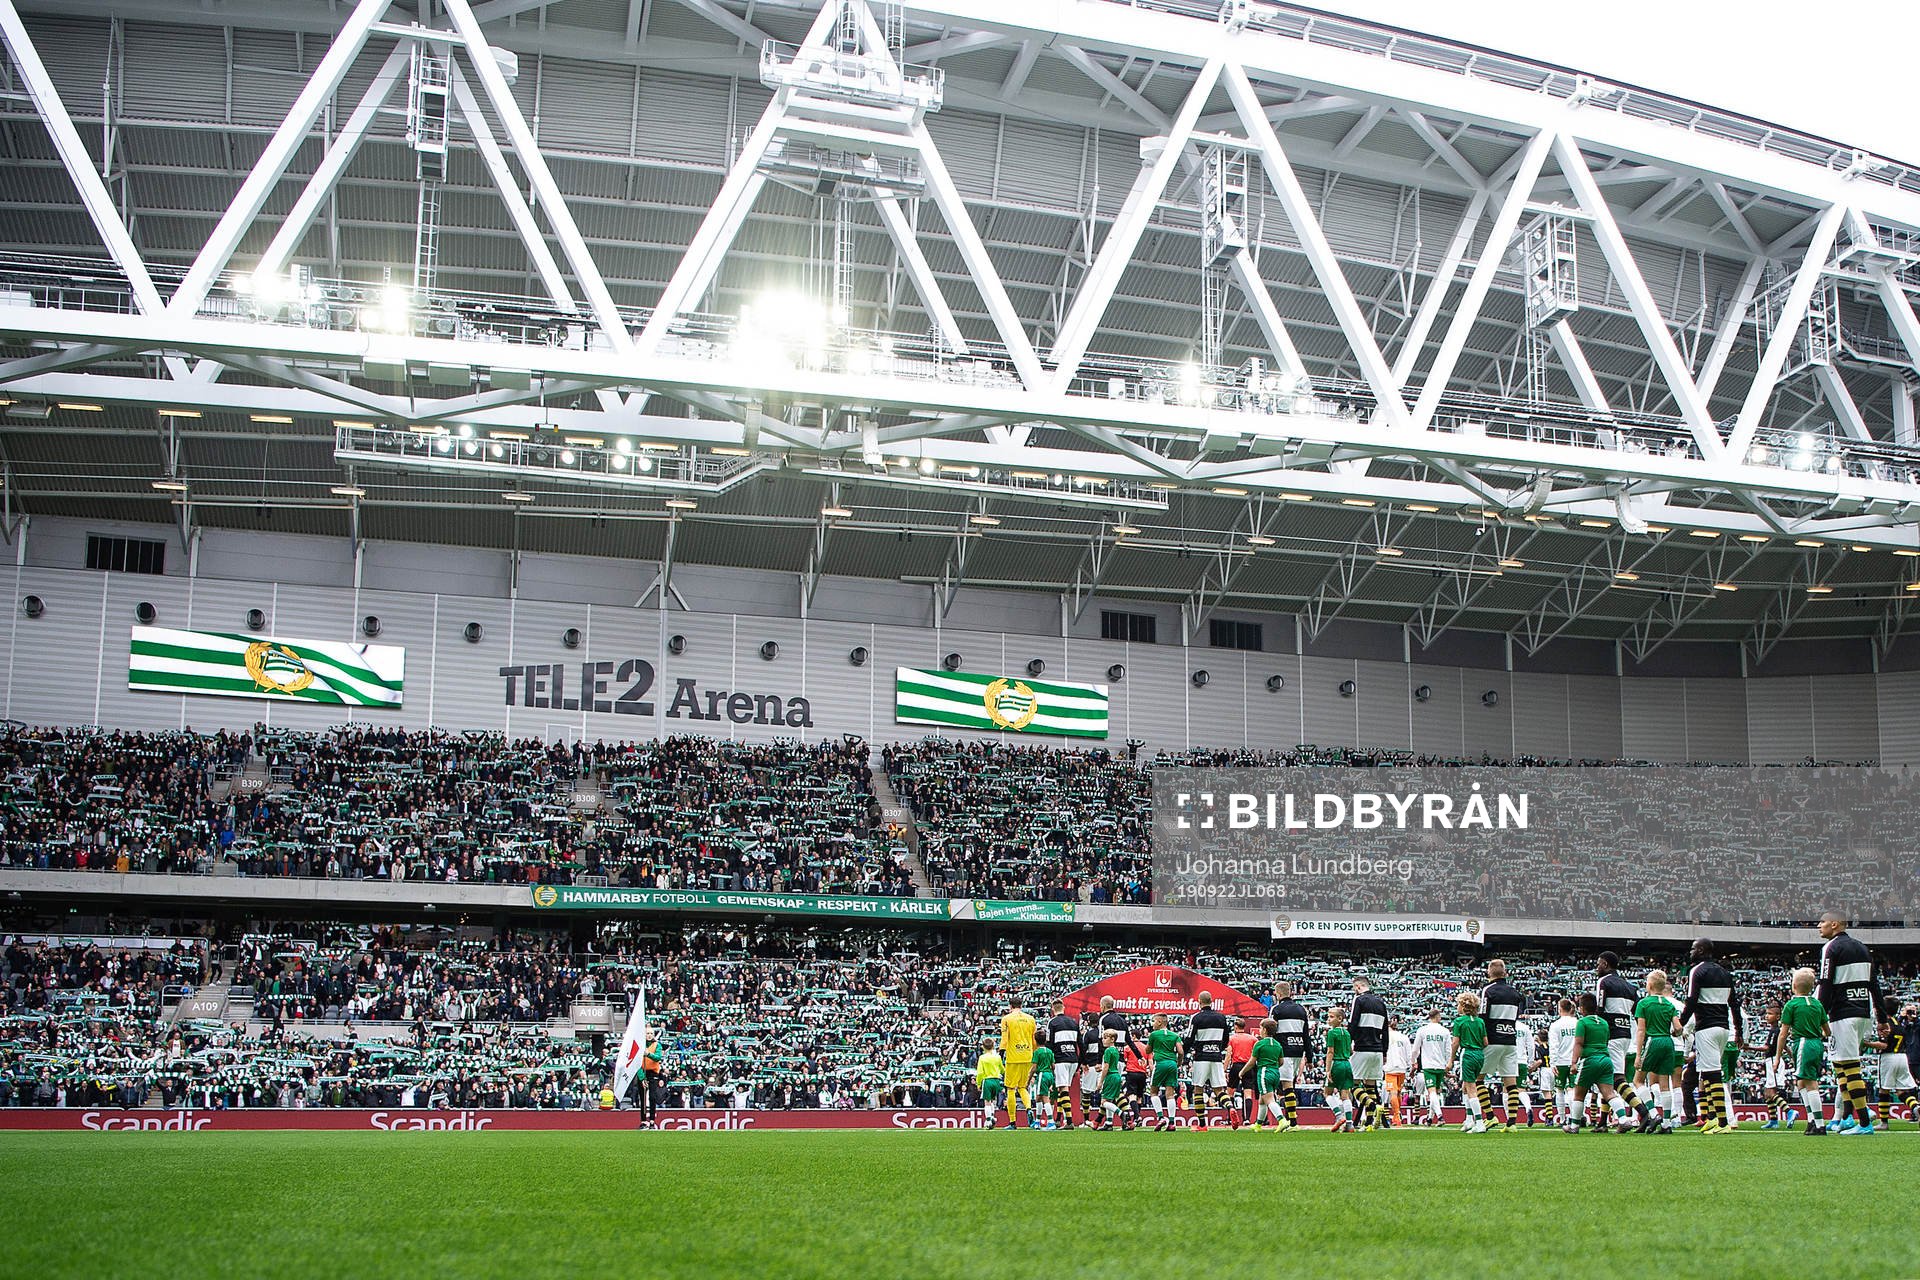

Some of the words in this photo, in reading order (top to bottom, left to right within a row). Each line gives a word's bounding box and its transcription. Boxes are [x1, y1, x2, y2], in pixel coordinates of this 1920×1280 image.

[499, 659, 655, 716] TELE2
[666, 678, 814, 728] Arena
[241, 779, 263, 788] B309
[576, 794, 596, 803] B308
[884, 809, 902, 818] B307
[563, 891, 650, 903] HAMMARBY
[653, 893, 710, 904] FOTBOLL
[717, 895, 805, 909] GEMENSKAP
[817, 900, 878, 912] RESPEKT
[890, 900, 943, 915] KÄRLEK
[979, 909, 1005, 919] Bajen
[1051, 912, 1073, 922] borta
[1318, 921, 1331, 930] EN
[1334, 922, 1371, 931] POSITIV
[1374, 922, 1462, 933] SUPPORTERKULTUR
[192, 1001, 218, 1012] A109
[1138, 996, 1154, 1009] för
[1154, 998, 1187, 1010] svensk
[579, 1008, 604, 1018] A108
[1893, 1034, 1904, 1053] 7
[81, 1111, 212, 1130] Scandic
[370, 1111, 493, 1130] Scandic
[655, 1111, 755, 1130] candic
[892, 1111, 984, 1130] Scandi
